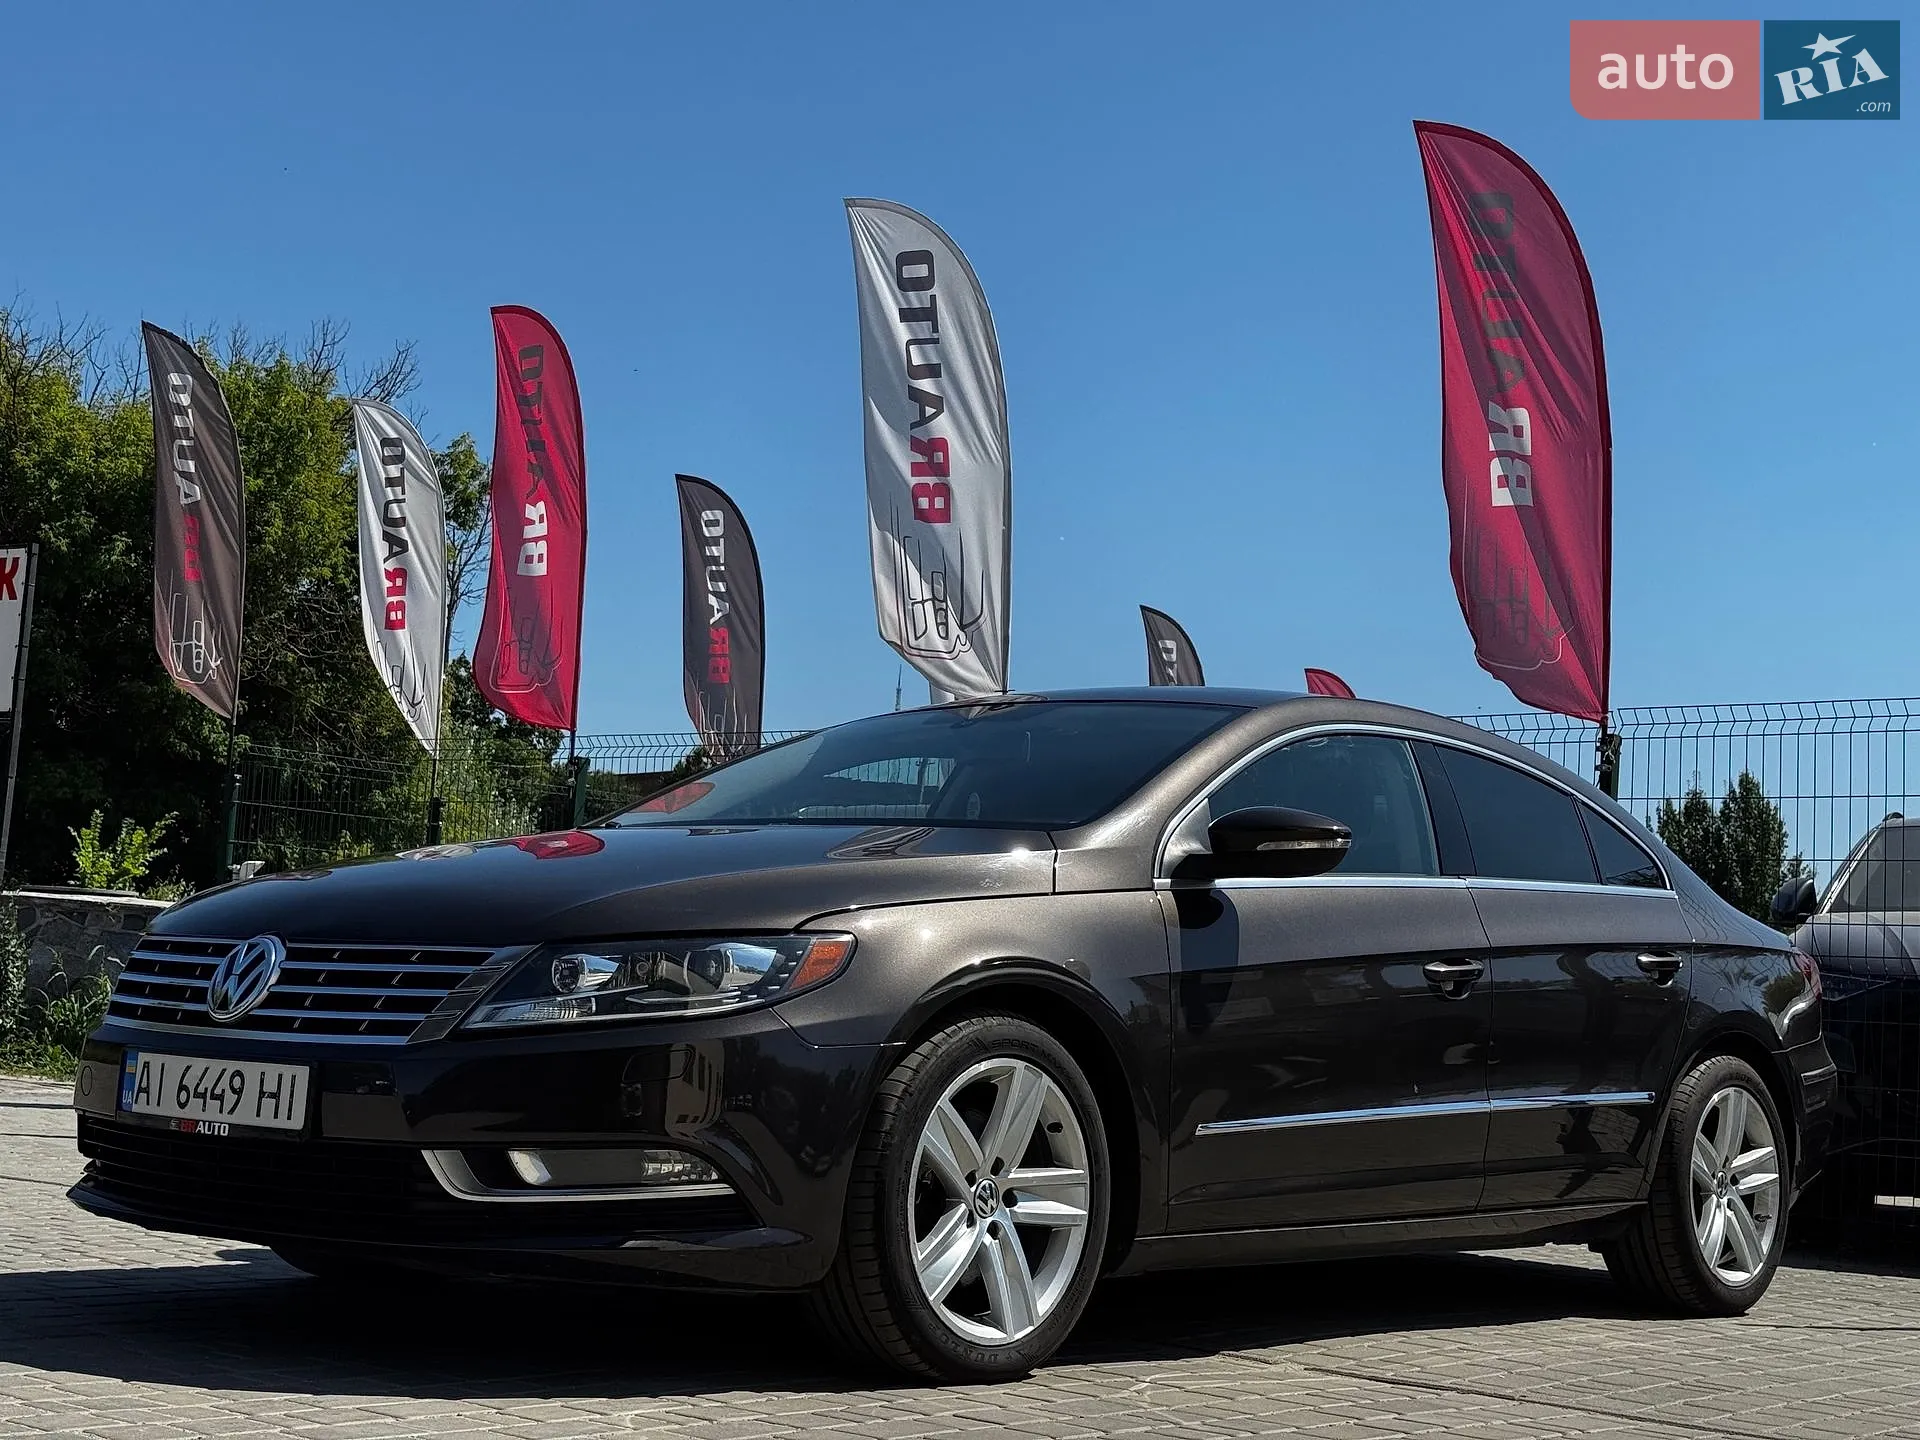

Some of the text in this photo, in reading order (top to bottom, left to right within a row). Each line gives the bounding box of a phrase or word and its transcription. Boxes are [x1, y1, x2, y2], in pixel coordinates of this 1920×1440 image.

[134, 1061, 297, 1121] AI 6449 HI
